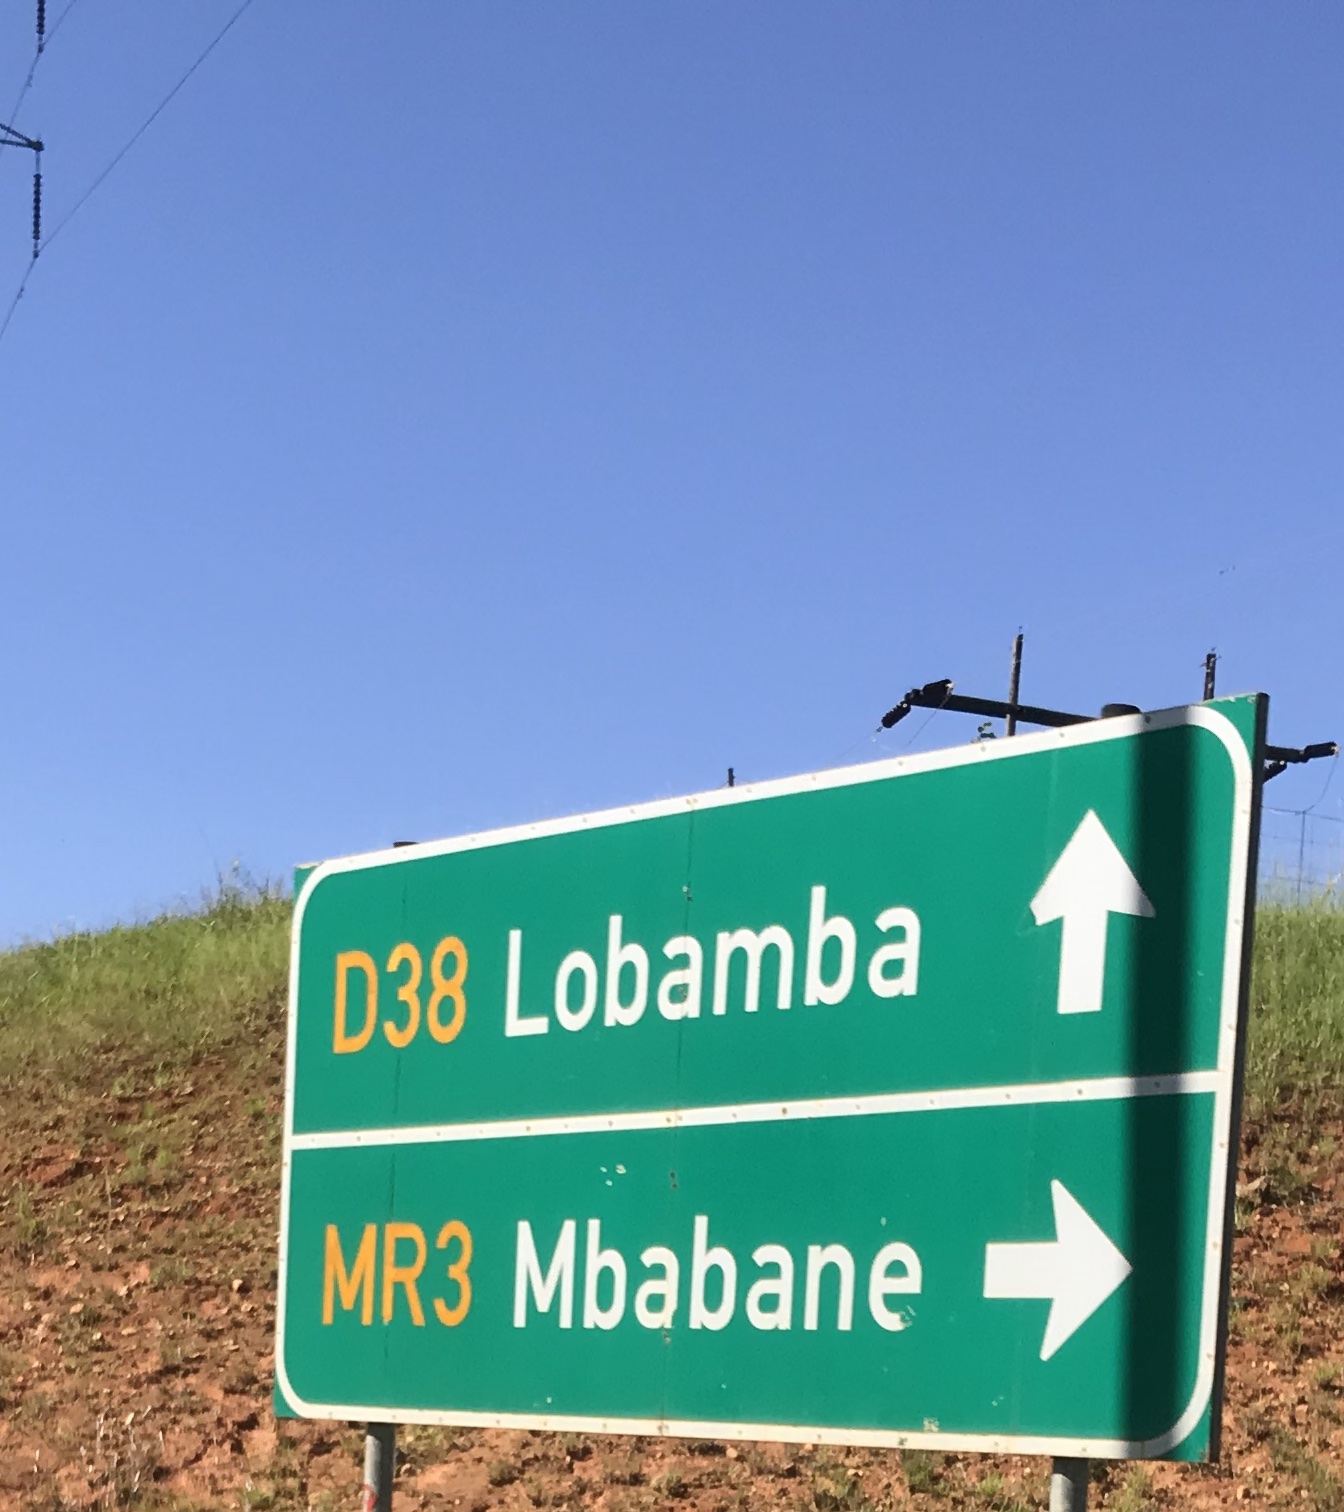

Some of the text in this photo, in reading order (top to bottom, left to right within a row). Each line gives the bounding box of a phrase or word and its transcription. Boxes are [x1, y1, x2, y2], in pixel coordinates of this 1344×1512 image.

[331, 885, 922, 1054] D38 Lobamba
[321, 1214, 924, 1332] MR3 Mbabane
